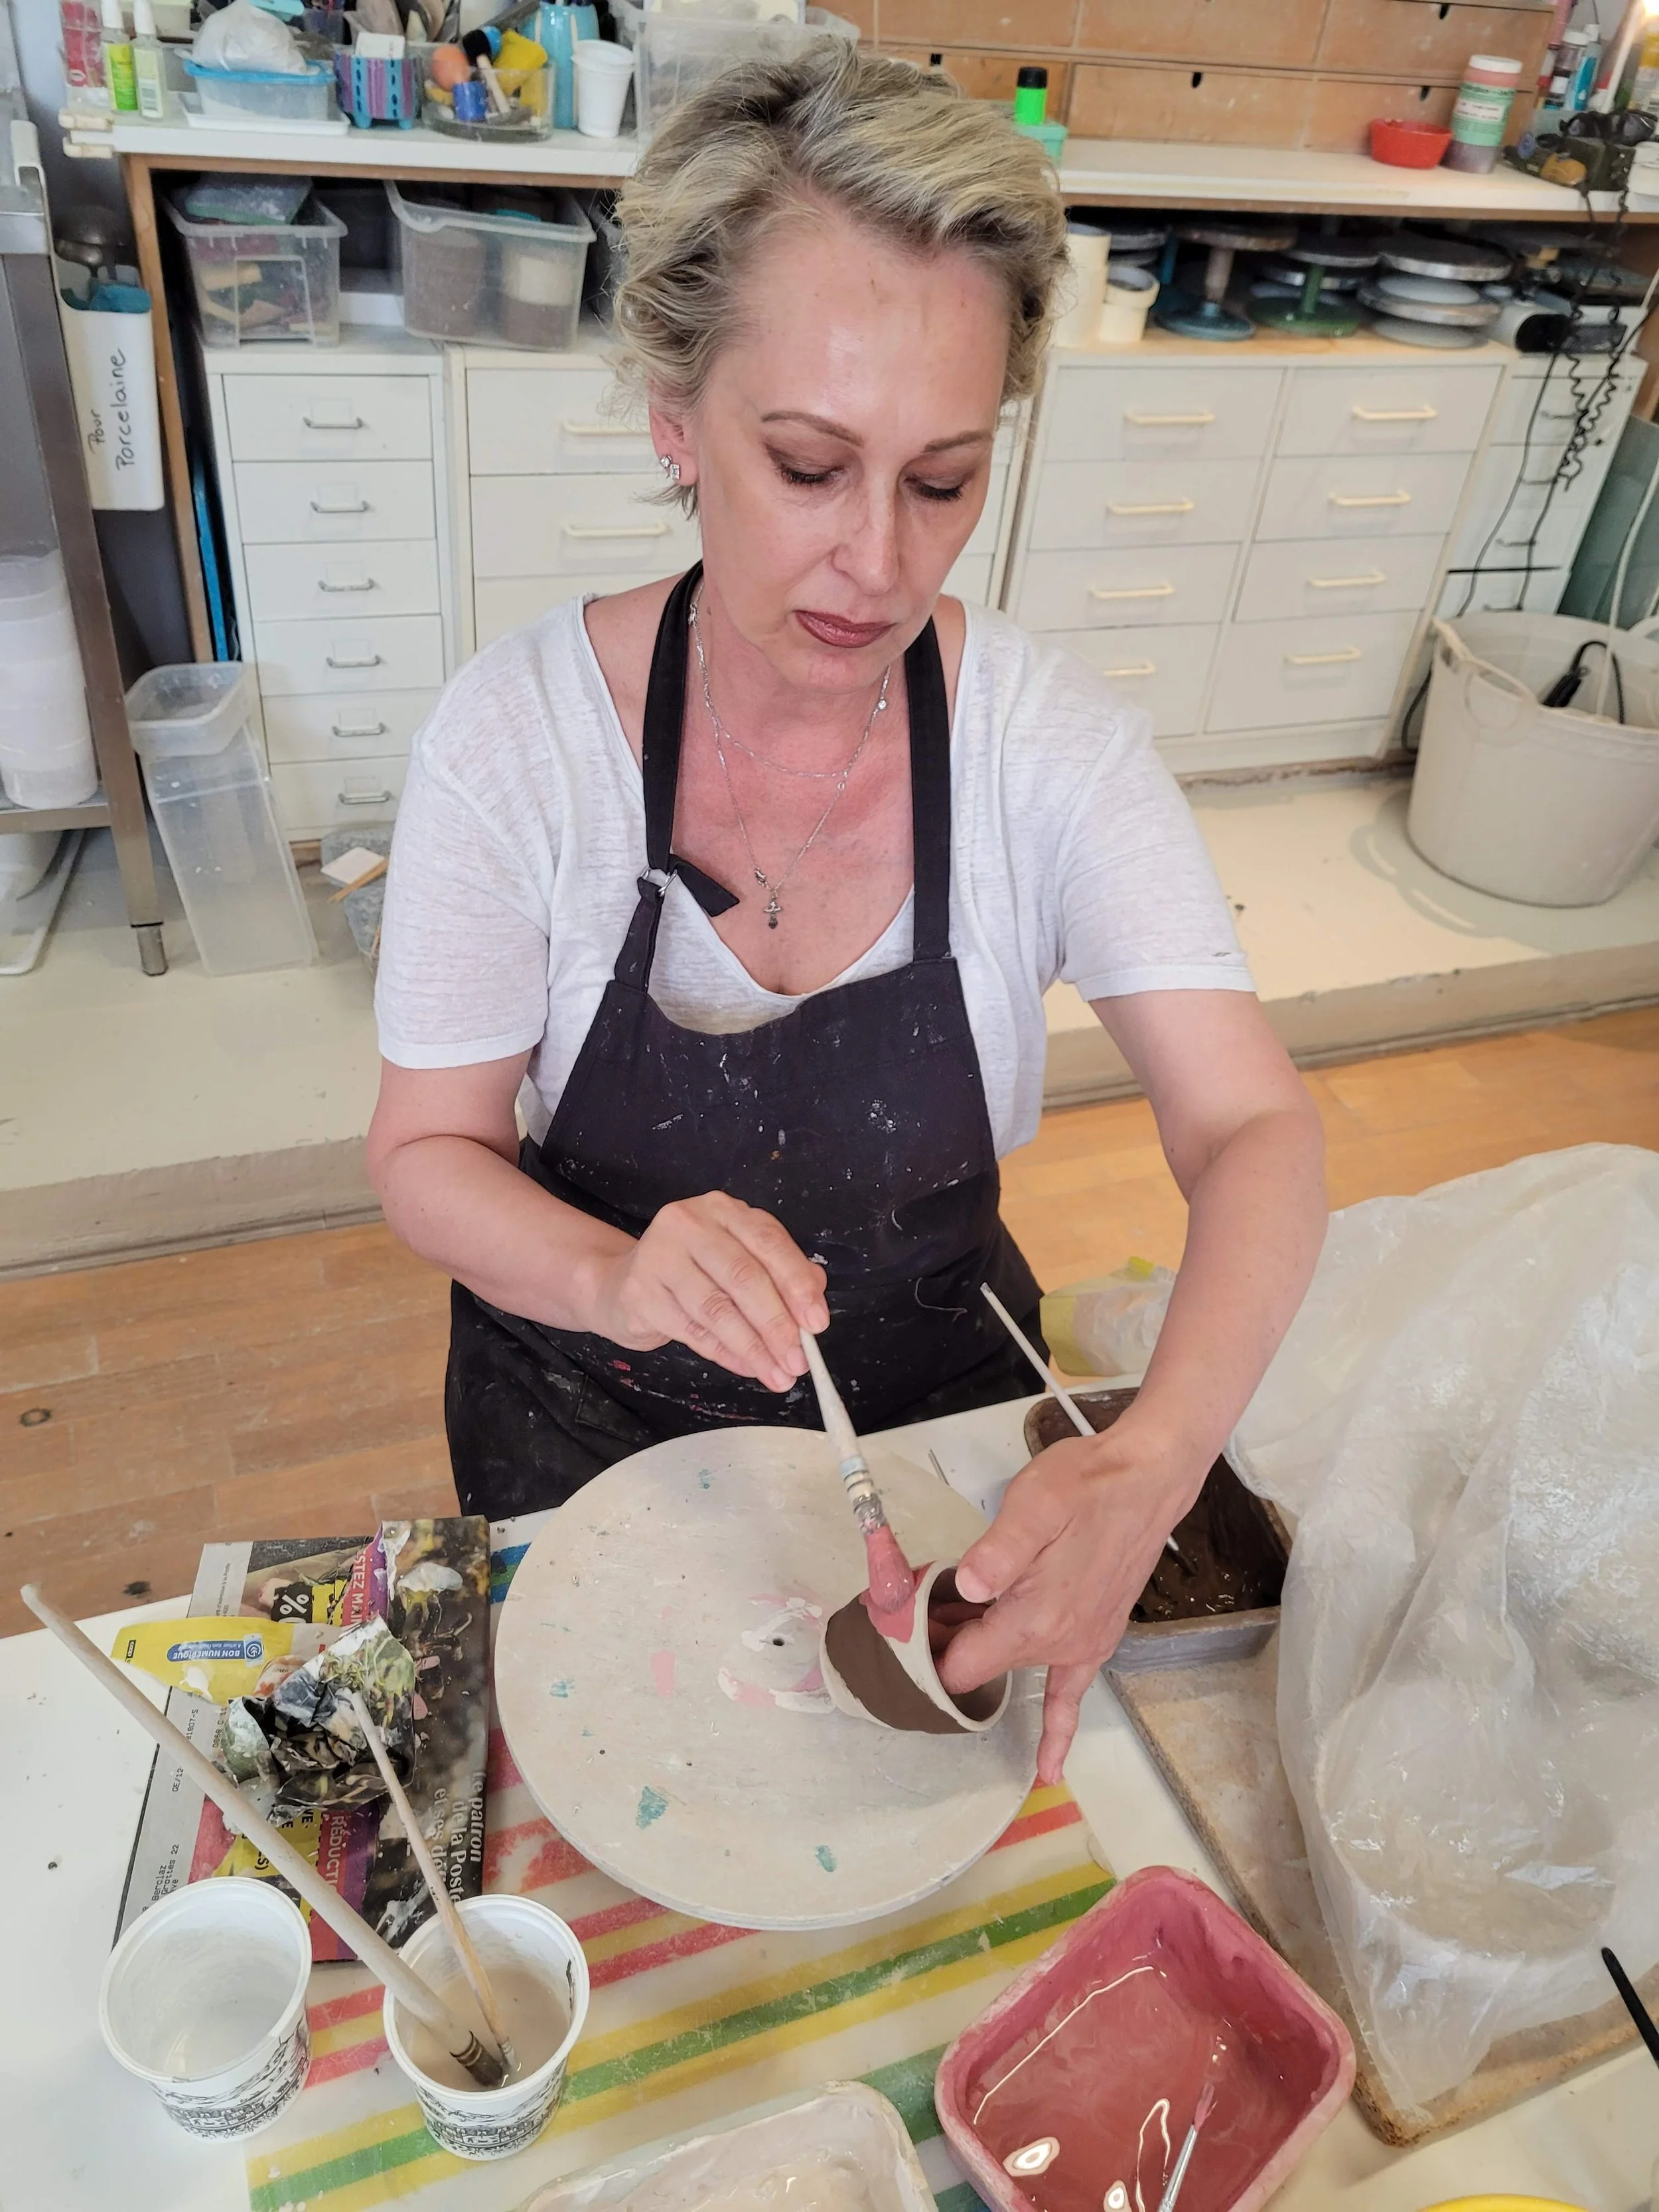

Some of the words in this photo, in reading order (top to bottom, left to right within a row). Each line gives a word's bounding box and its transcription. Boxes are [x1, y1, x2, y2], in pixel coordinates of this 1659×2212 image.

[110, 347, 135, 471] Porcelaine
[88, 409, 106, 455] Pour
[434, 1788, 447, 1806] et
[472, 1772, 486, 1793] Le
[431, 1809, 445, 1842] ses
[452, 1801, 468, 1824] de
[469, 1797, 484, 1862] patron
[451, 1826, 467, 1846] la
[151, 1865, 167, 1901] Berclaz
[161, 1860, 176, 1895] Grottes
[171, 1844, 180, 1854] 22
[449, 1850, 467, 1903] Poste
